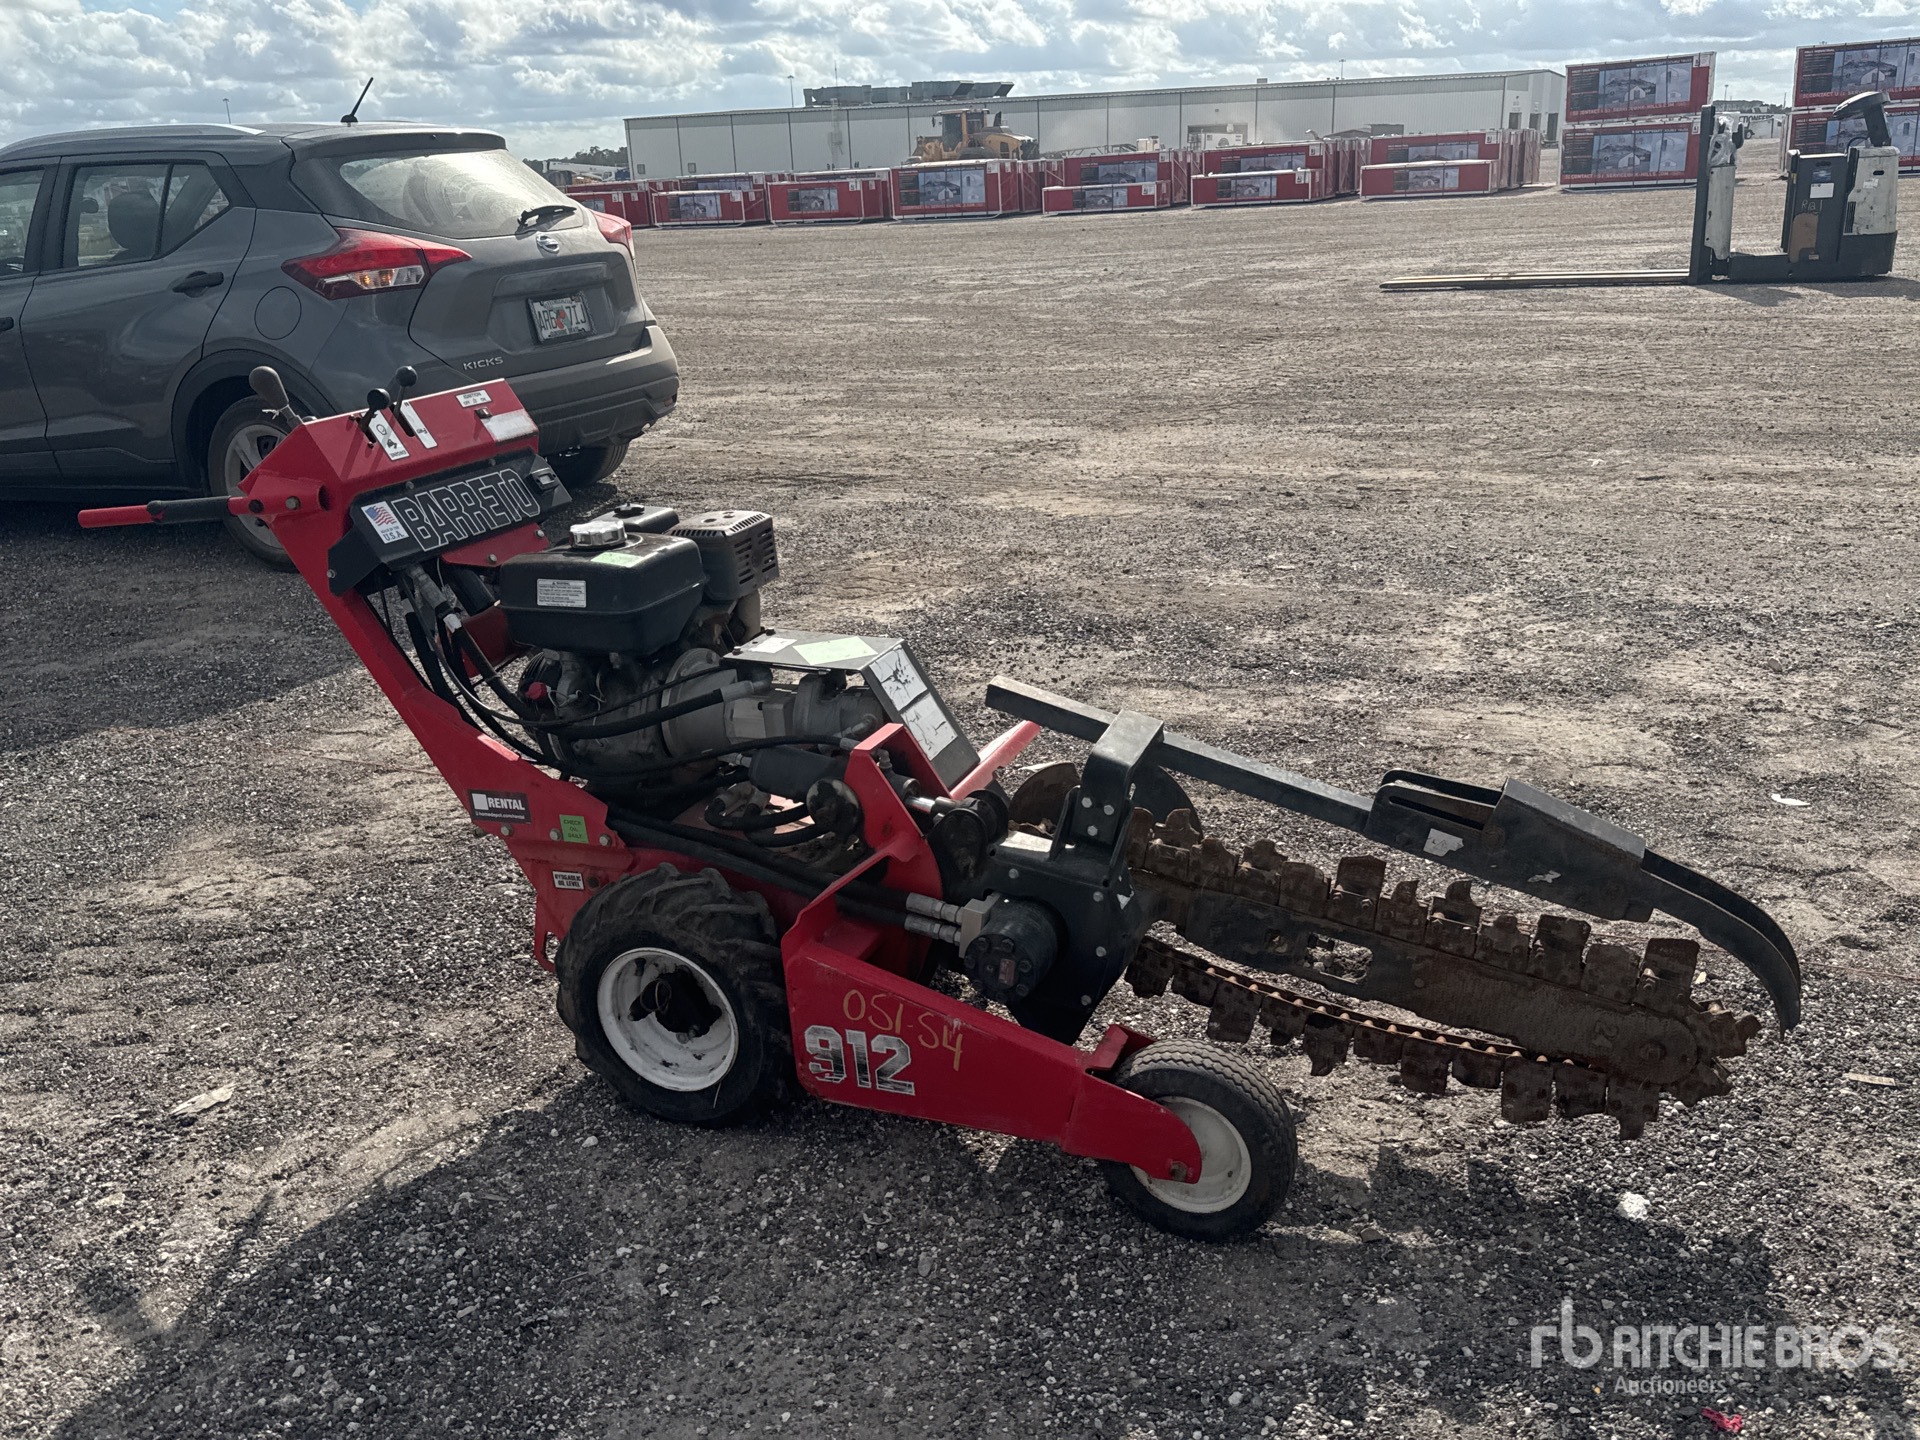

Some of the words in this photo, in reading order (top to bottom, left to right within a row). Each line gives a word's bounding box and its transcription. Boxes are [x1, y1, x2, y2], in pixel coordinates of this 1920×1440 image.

[463, 356, 504, 370] KICKS
[391, 468, 541, 551] BARRETO
[487, 797, 526, 811] RENTAL
[804, 1025, 915, 1096] 912
